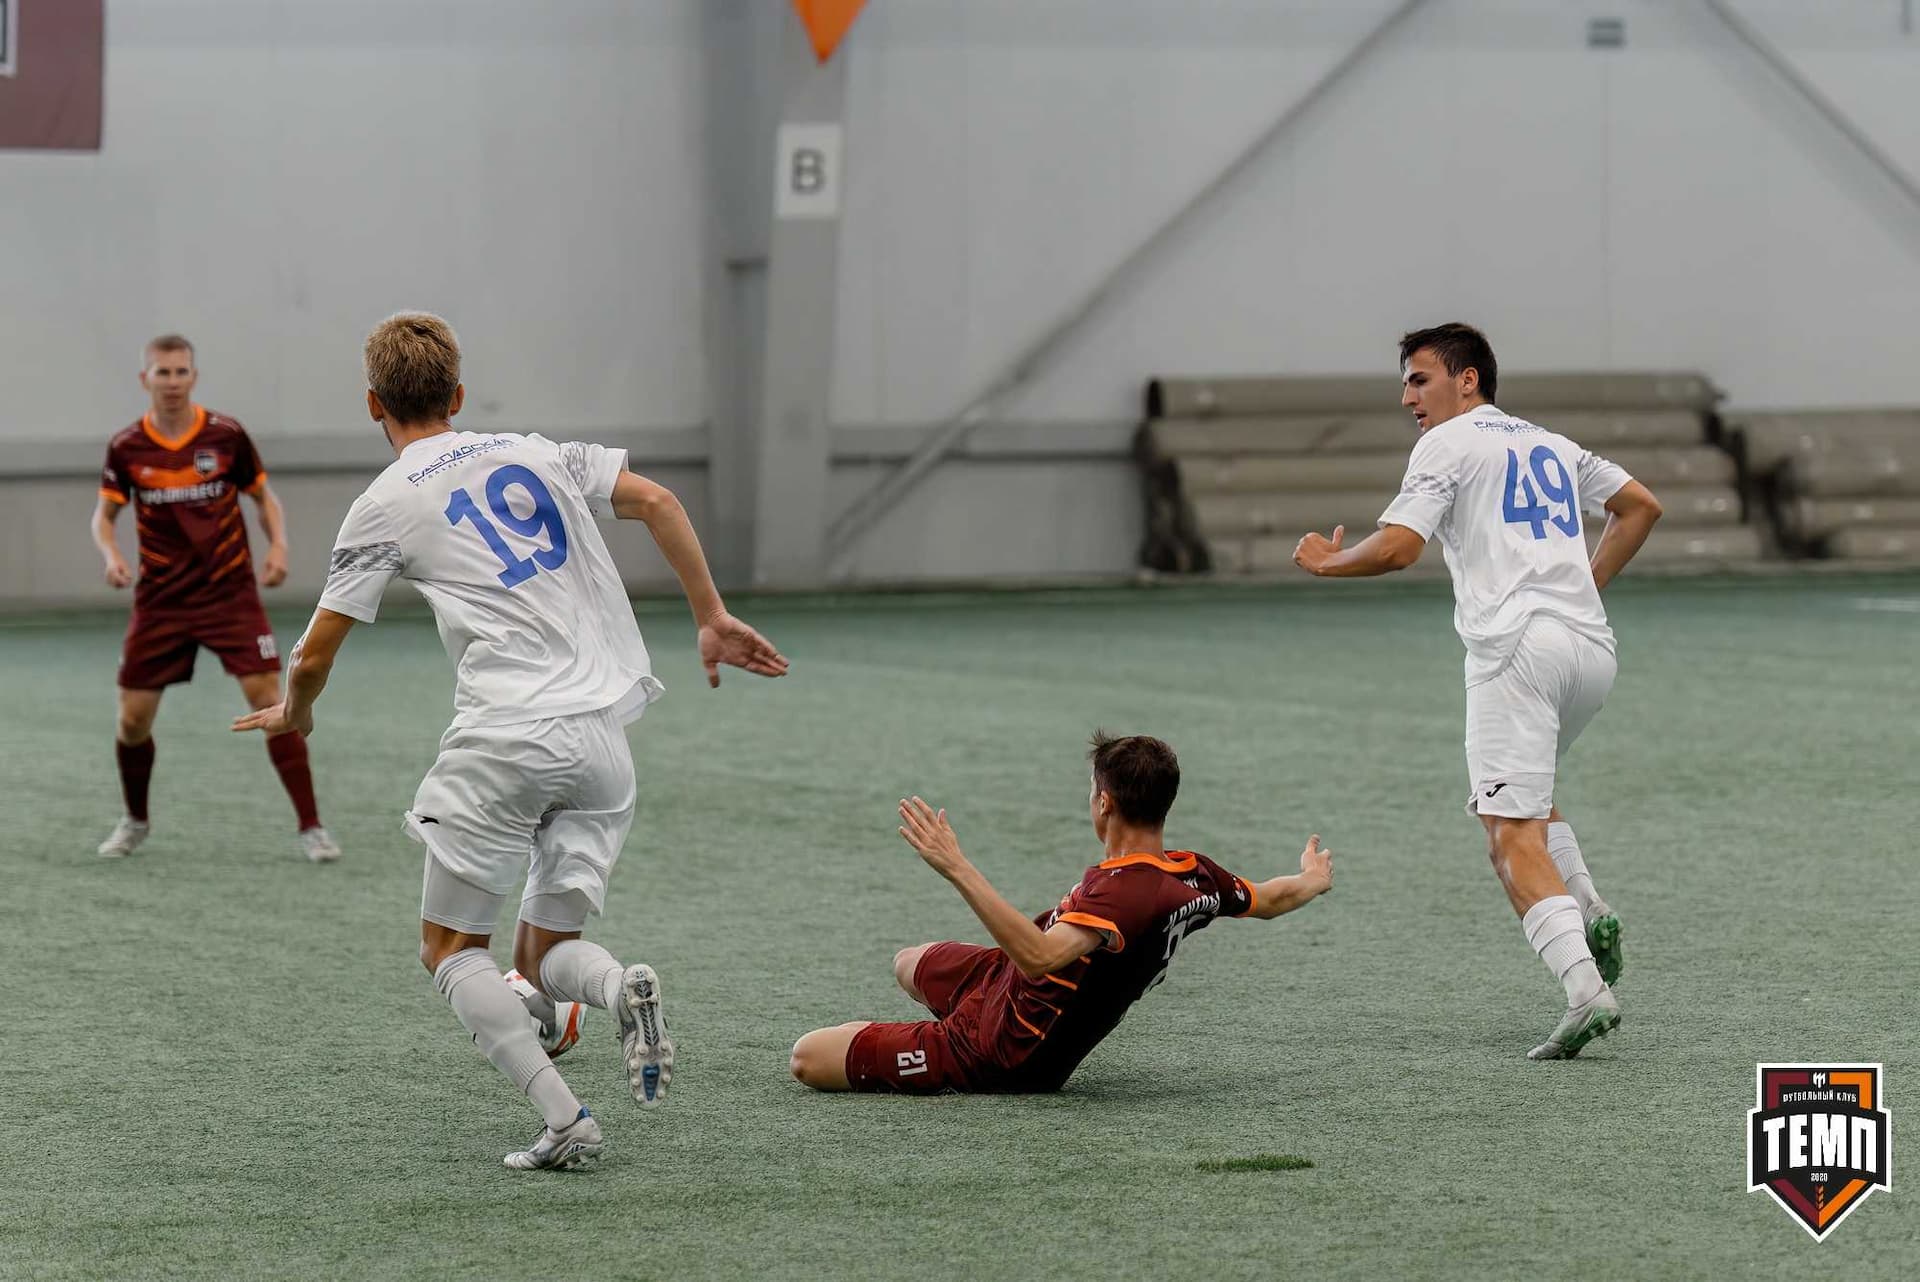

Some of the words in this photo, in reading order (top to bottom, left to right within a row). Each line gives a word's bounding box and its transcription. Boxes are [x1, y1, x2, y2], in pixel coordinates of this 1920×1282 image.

[444, 464, 567, 589] 19
[1502, 445, 1579, 540] 49
[897, 1050, 928, 1076] 21
